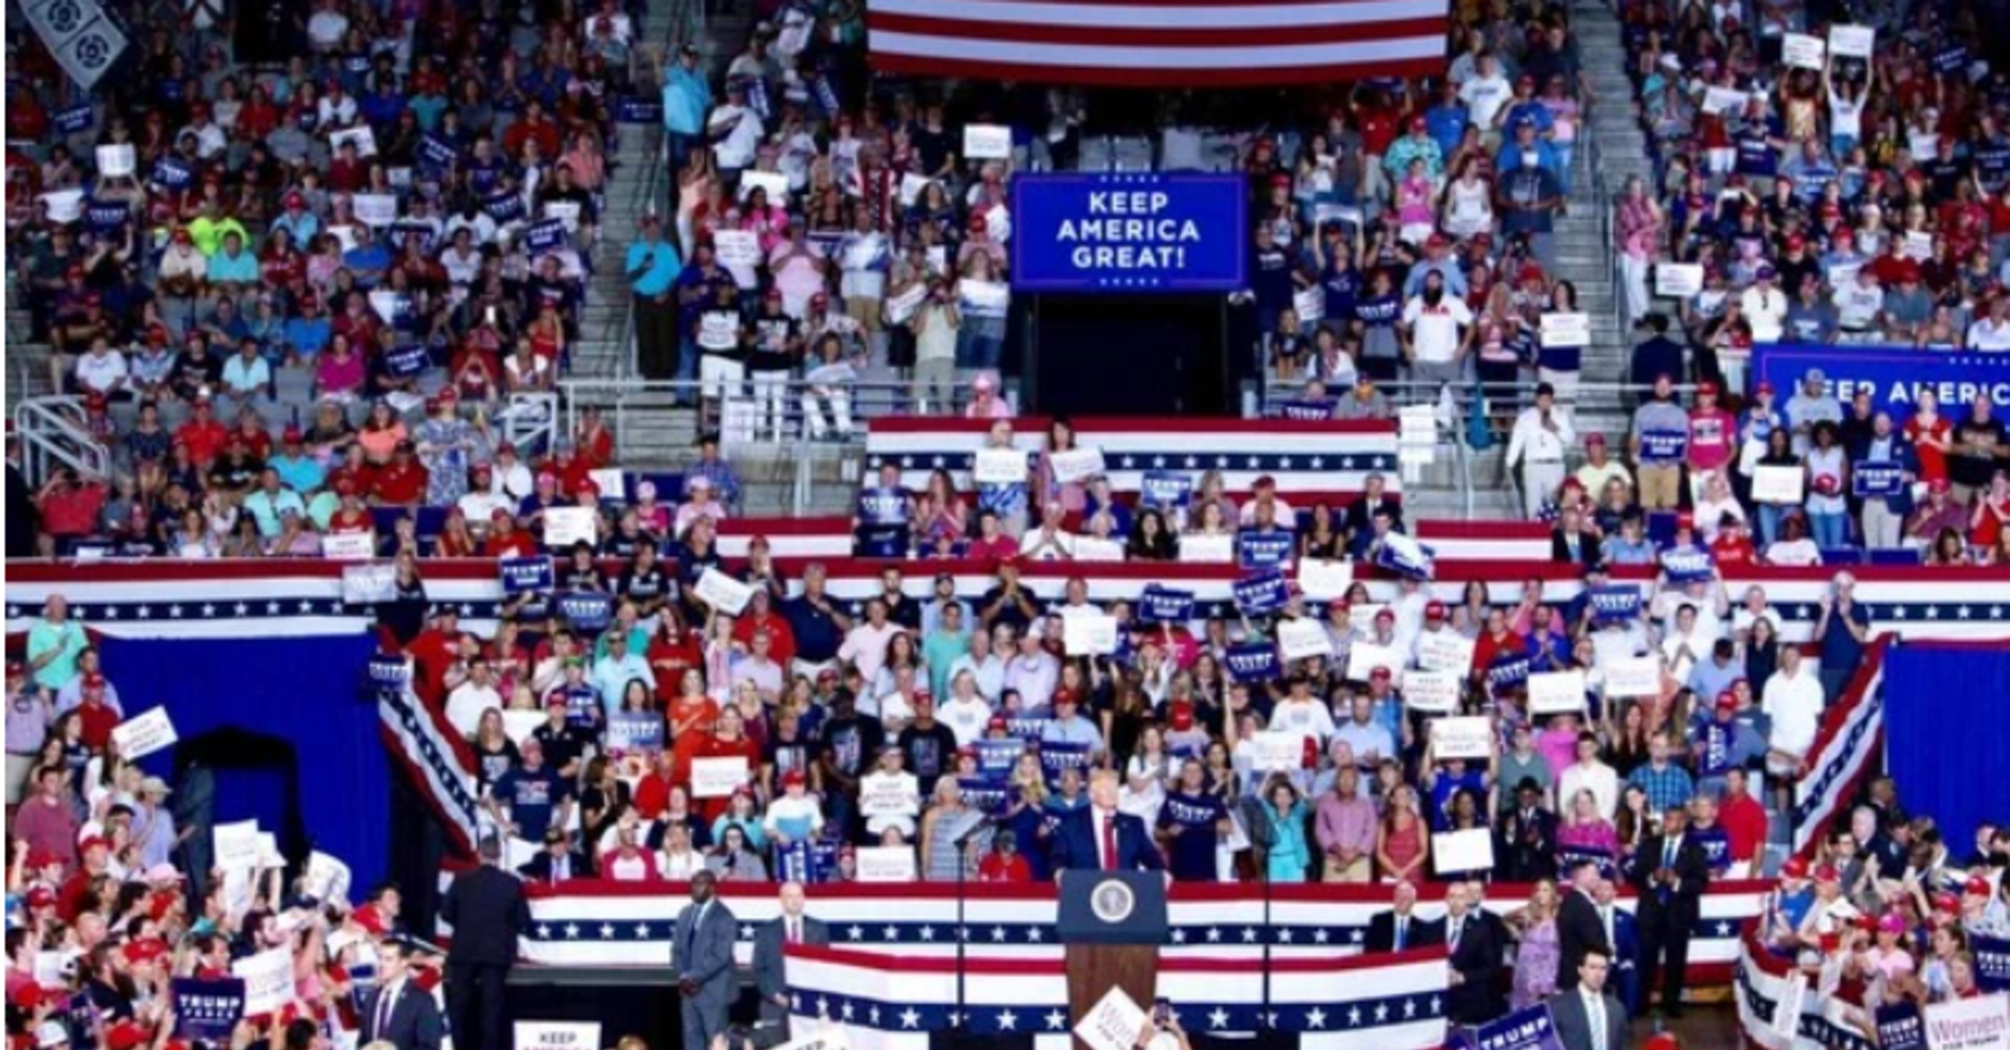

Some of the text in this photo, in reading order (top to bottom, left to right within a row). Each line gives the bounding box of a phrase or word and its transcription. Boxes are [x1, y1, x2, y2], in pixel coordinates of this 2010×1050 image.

[1088, 191, 1169, 214] KEEP
[1056, 219, 1201, 243] AMERICA
[1071, 246, 1187, 269] GREAT!
[178, 994, 241, 1009] TRUMP
[538, 1031, 577, 1044] KEEP
[1480, 1015, 1548, 1050] TRUMP
[1930, 1015, 2006, 1044] Women
